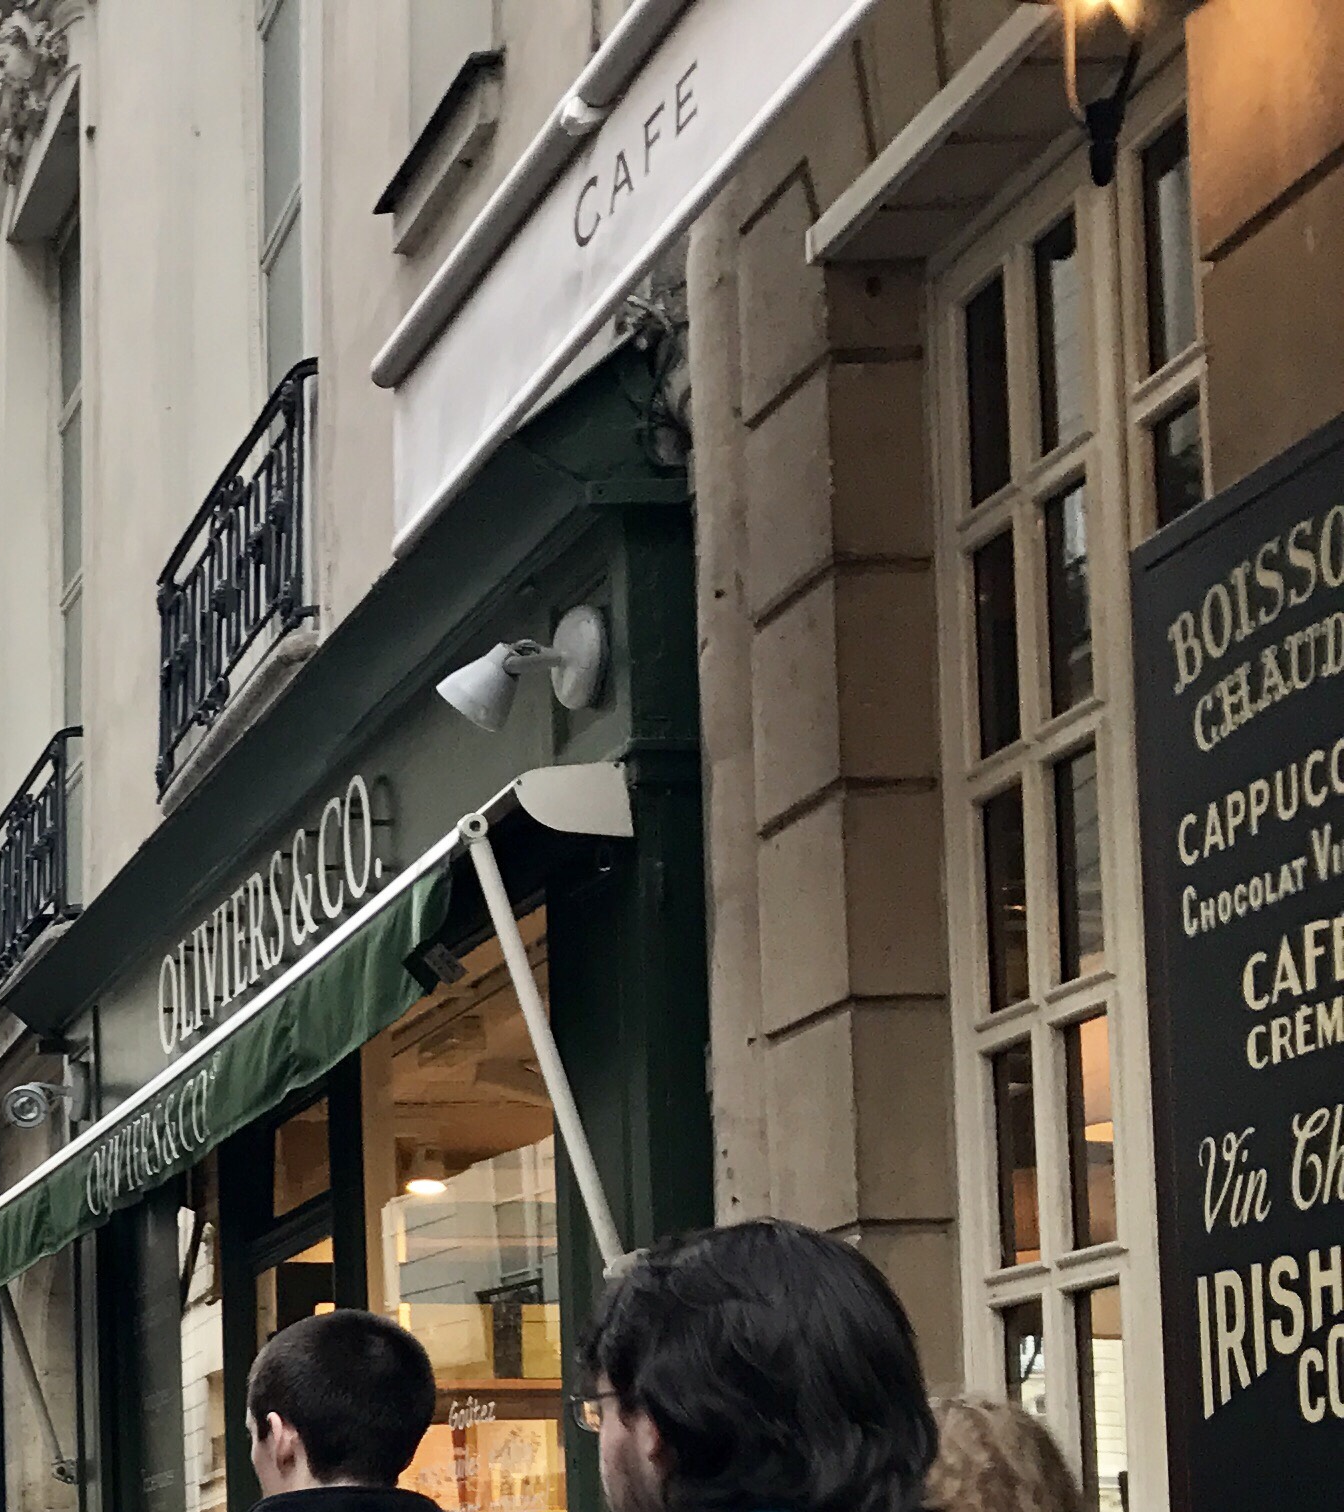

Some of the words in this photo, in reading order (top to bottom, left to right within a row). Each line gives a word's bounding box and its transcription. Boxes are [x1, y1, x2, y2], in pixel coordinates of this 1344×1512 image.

[575, 57, 698, 247] CAFE
[158, 774, 382, 1054] OLIVIERS&CO.
[1198, 1127, 1272, 1234] Vin
[1197, 1245, 1343, 1420] IRISH
